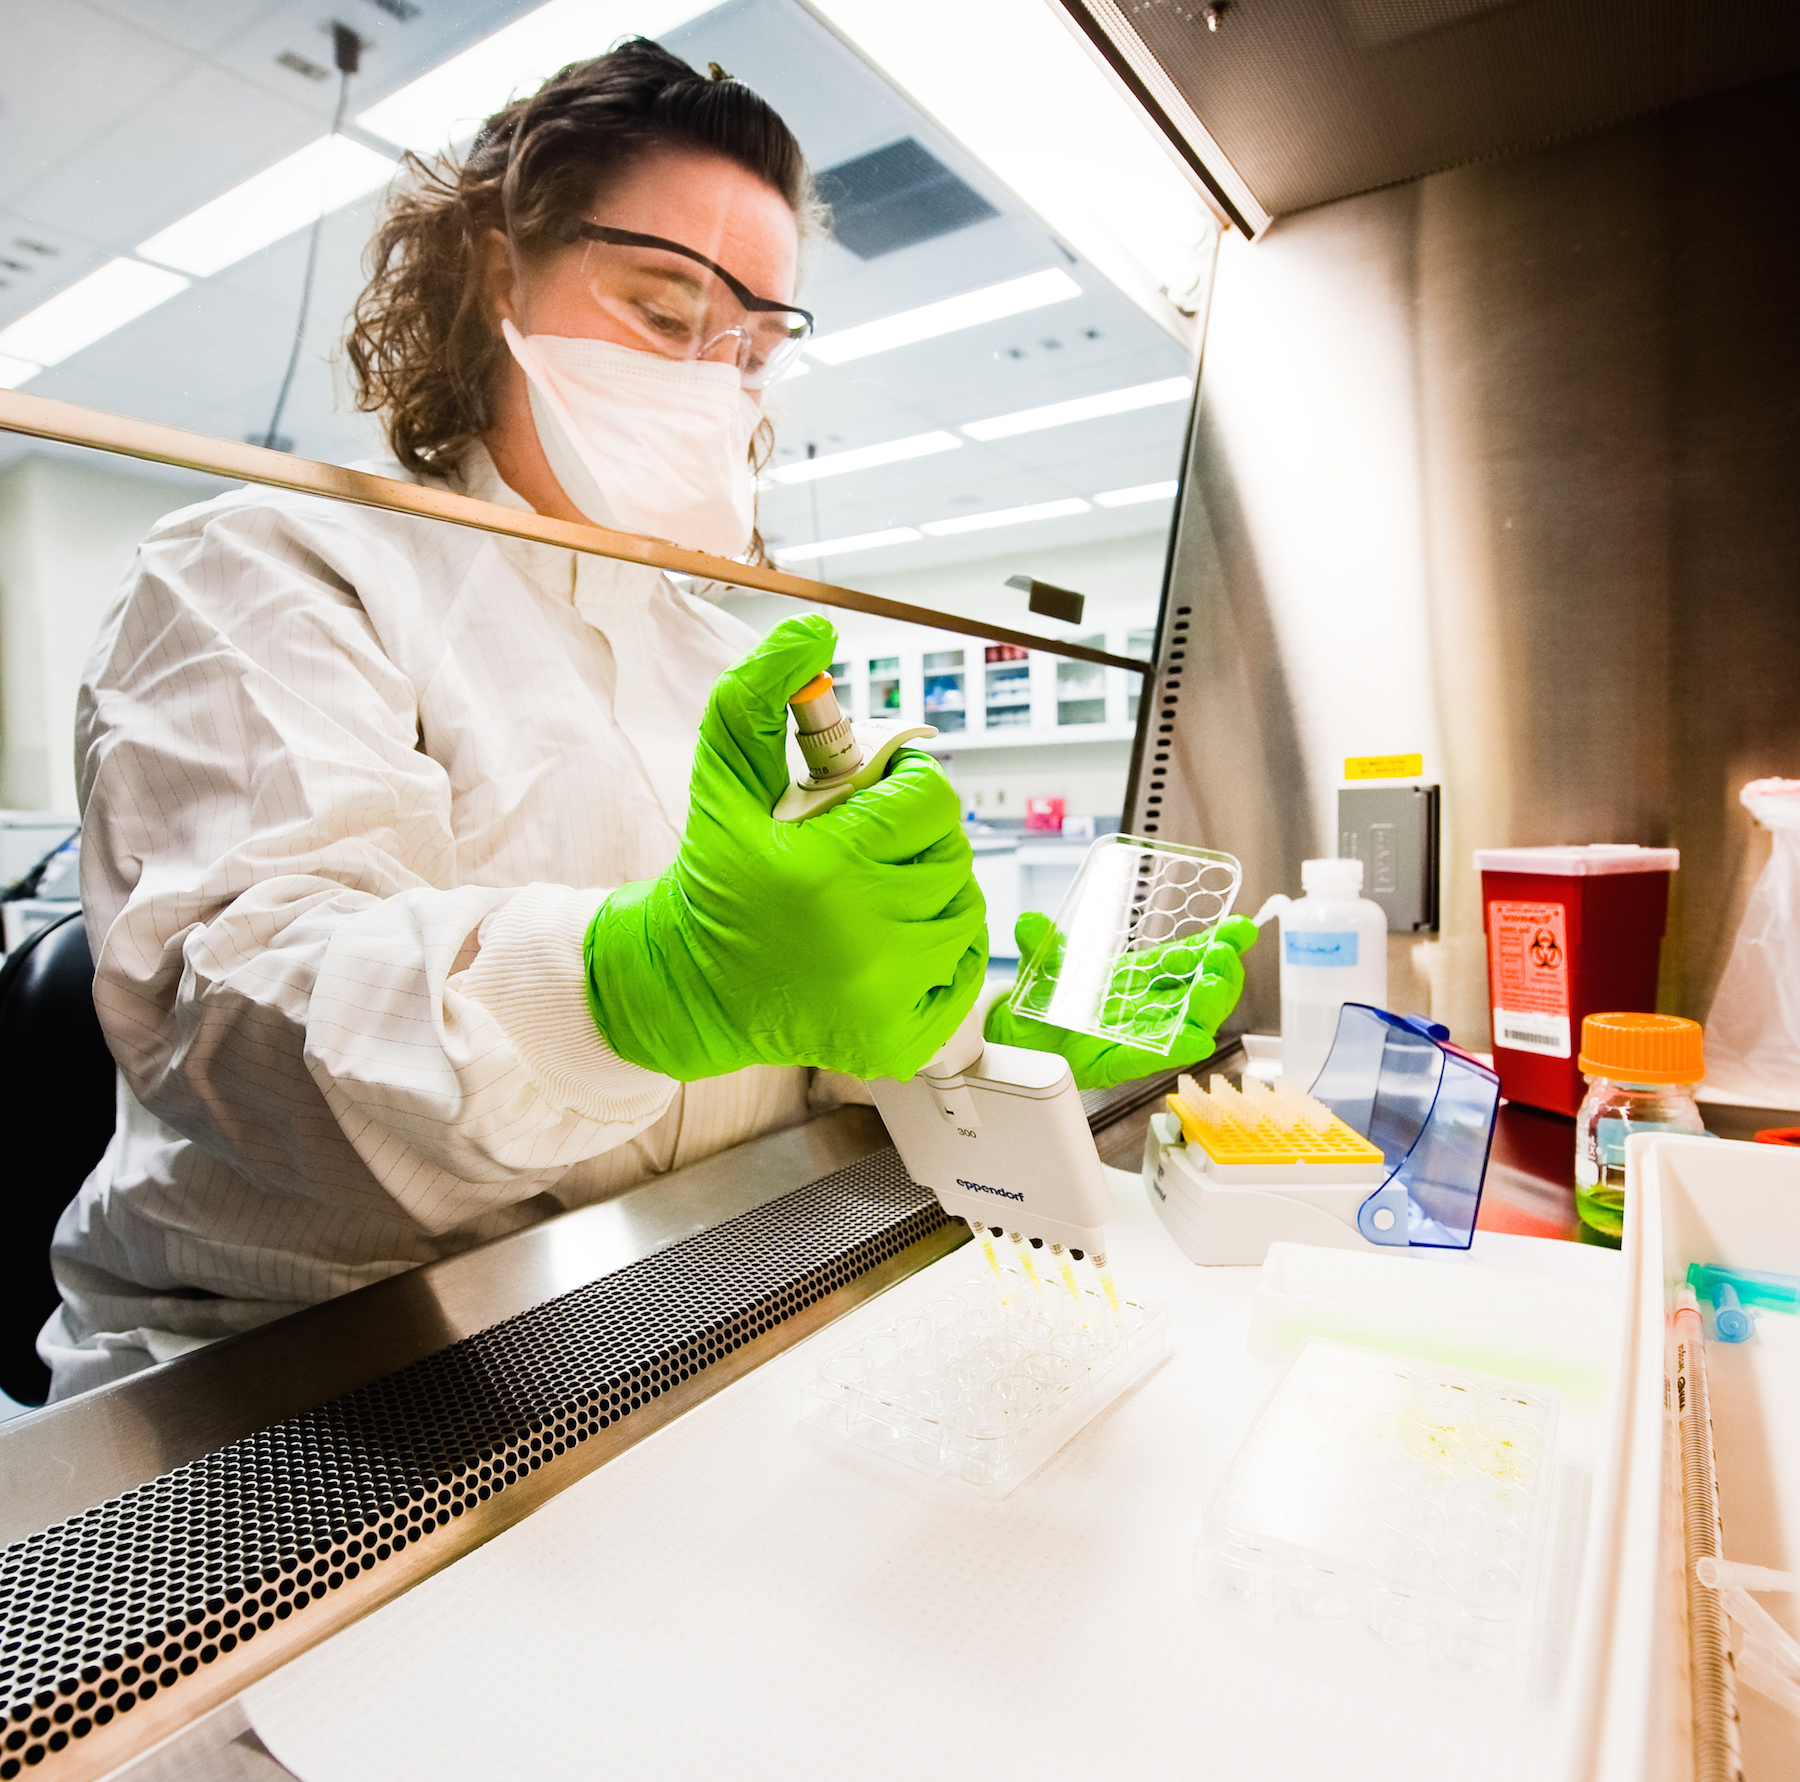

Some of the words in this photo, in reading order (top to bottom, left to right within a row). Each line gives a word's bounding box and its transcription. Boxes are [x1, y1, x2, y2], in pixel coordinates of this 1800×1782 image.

[811, 766, 829, 775] 718
[957, 1127, 977, 1138] 300
[956, 1178, 1024, 1202] eppendorf
